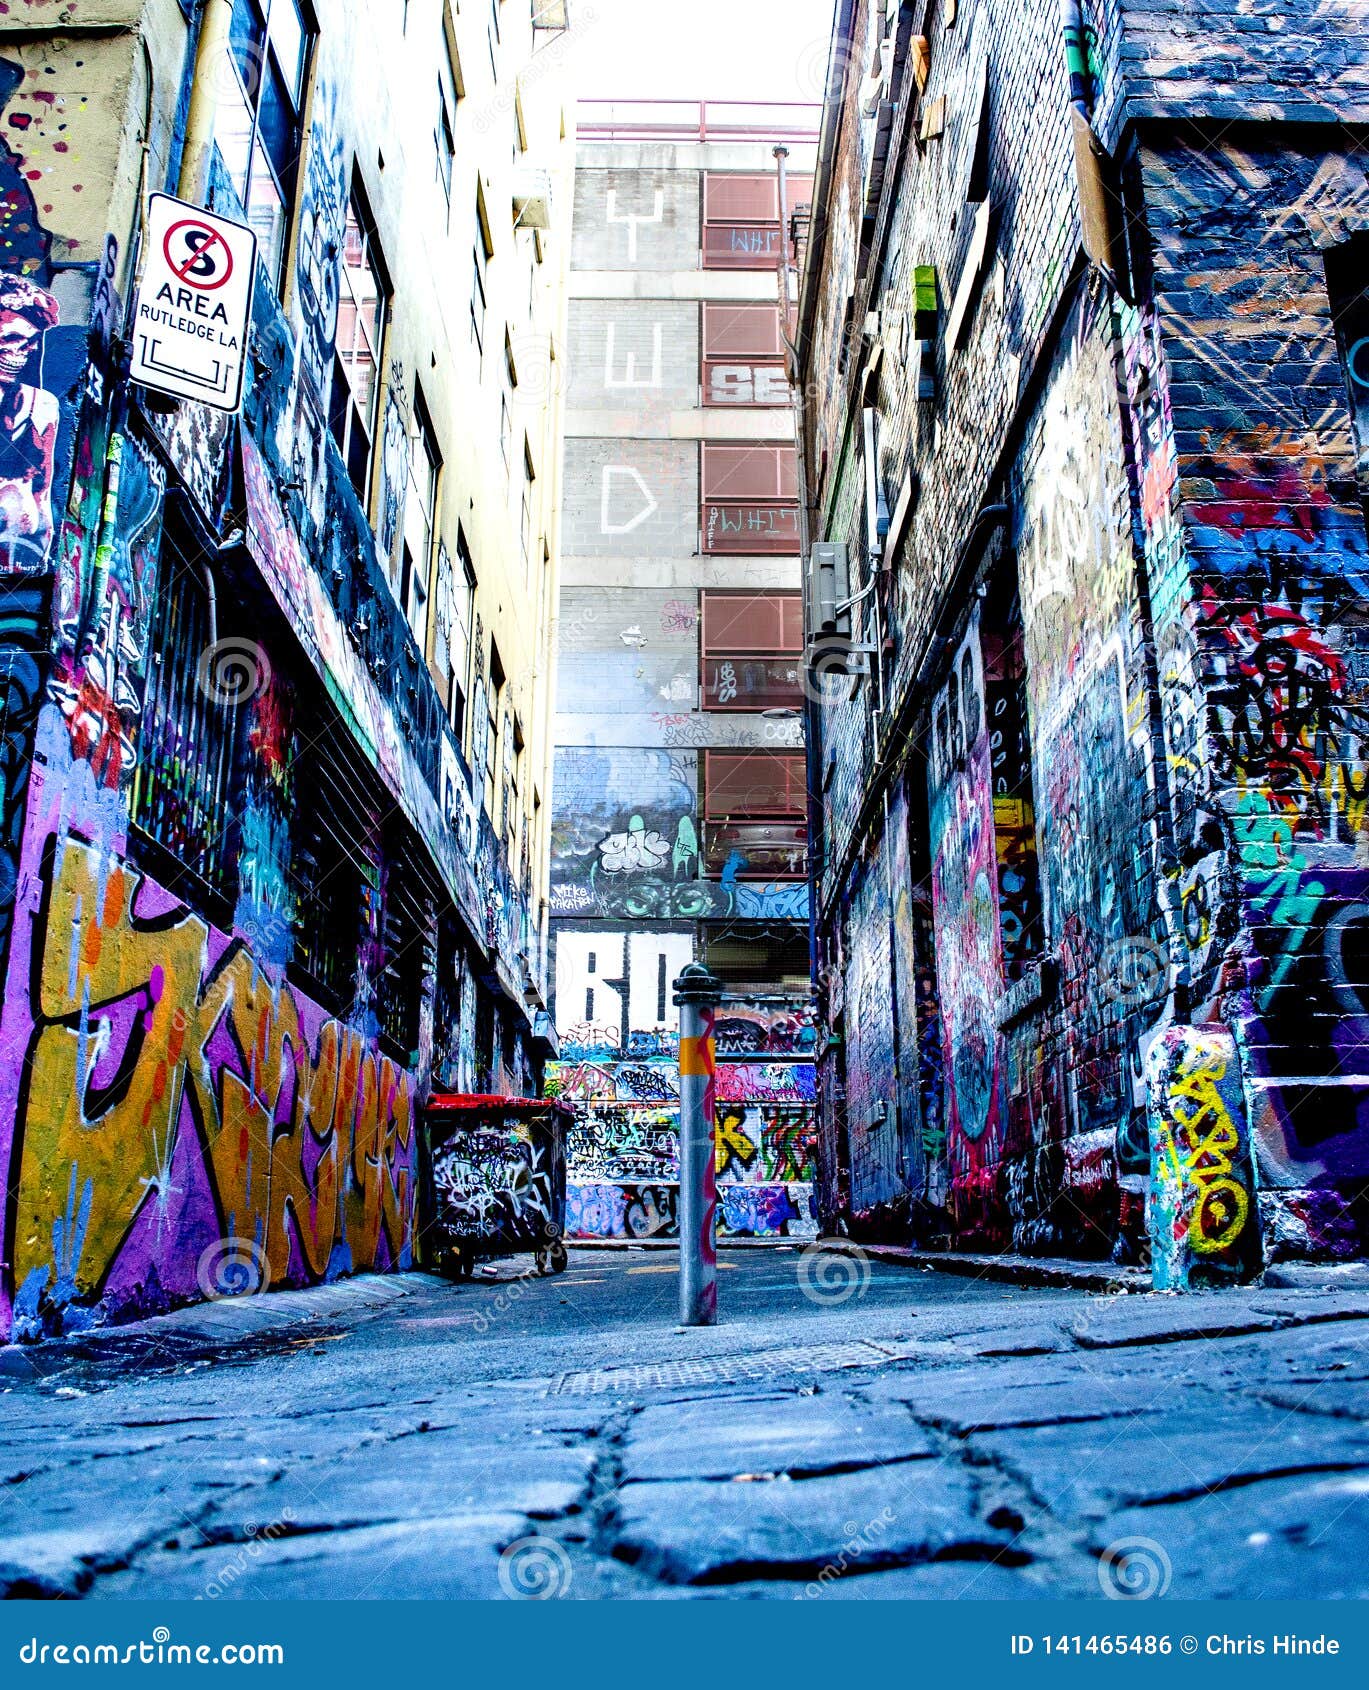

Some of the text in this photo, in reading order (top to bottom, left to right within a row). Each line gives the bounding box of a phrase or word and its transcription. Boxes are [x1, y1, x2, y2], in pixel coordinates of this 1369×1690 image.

[156, 282, 228, 325] AREA
[140, 303, 238, 350] RUTLEDGE LA
